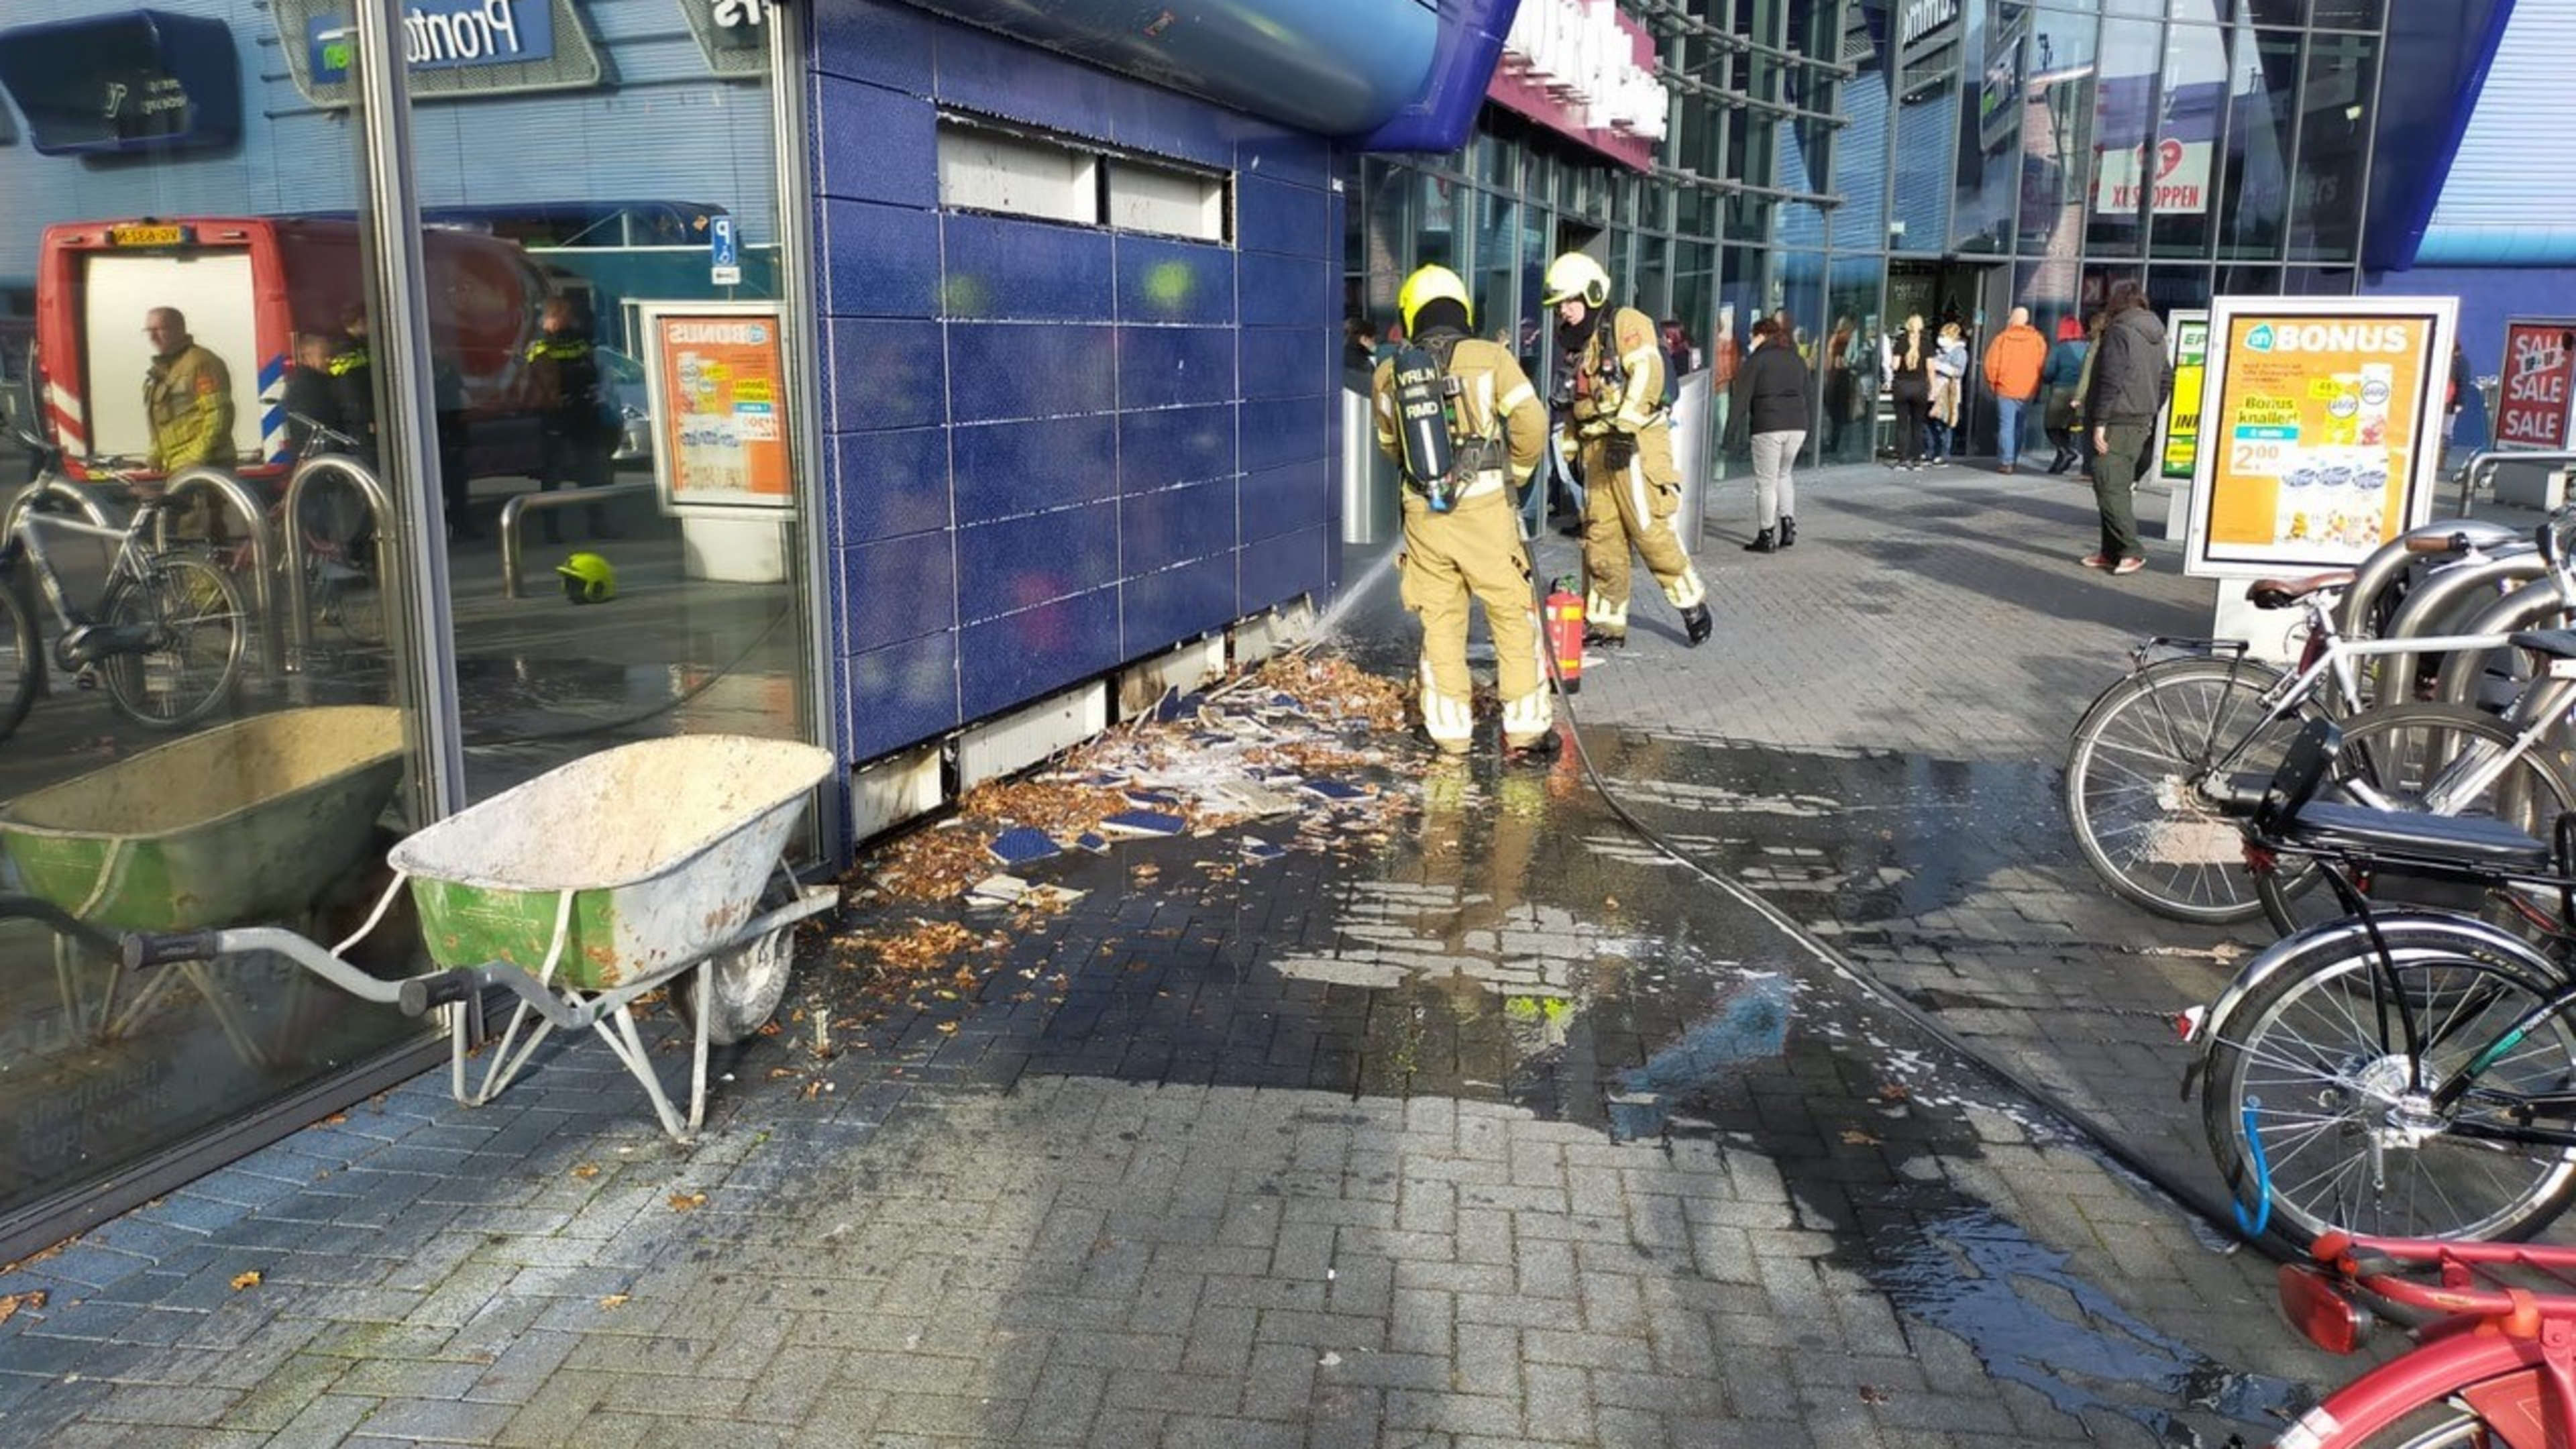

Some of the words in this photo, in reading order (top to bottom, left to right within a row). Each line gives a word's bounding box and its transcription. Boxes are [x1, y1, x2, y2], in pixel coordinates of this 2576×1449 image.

[2131, 184, 2199, 208] SOPPEN
[2275, 324, 2408, 353] BONUS
[1397, 368, 1435, 386] VRLN
[2509, 374, 2563, 403] SALE
[2245, 396, 2294, 410] Bonus
[2505, 409, 2559, 439] SALE
